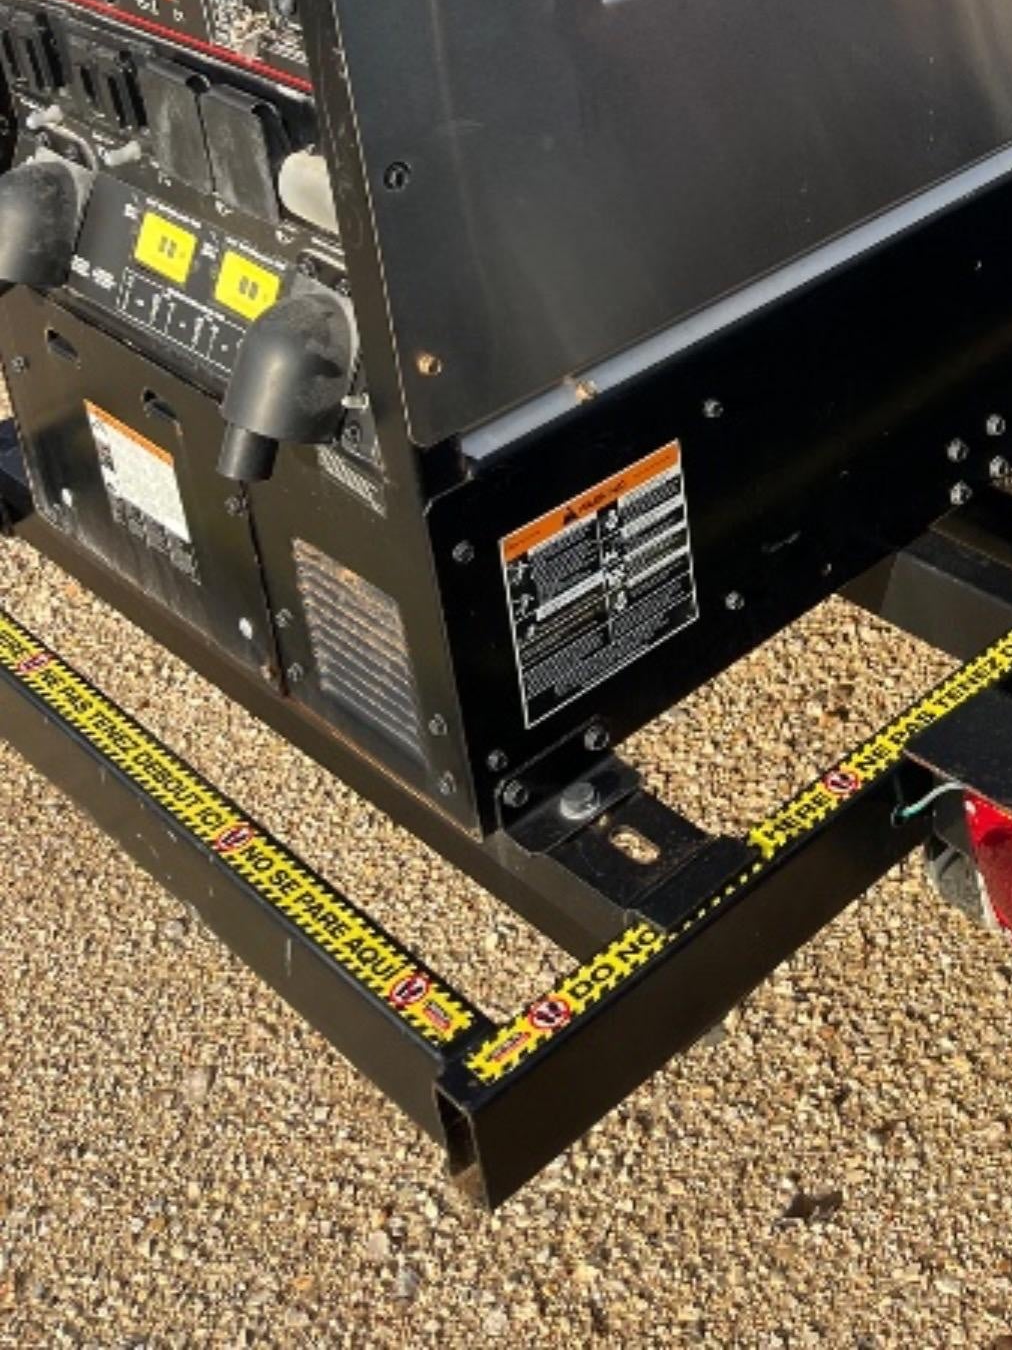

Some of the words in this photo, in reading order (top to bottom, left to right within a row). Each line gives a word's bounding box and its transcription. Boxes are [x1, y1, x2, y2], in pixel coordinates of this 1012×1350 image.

[89, 710, 141, 754] TENEZ
[133, 751, 201, 808] DEBOUT
[240, 845, 275, 872] NO
[269, 869, 301, 896] SE
[293, 891, 351, 941] PARE
[567, 962, 616, 998] DO
[616, 929, 658, 962] NO
